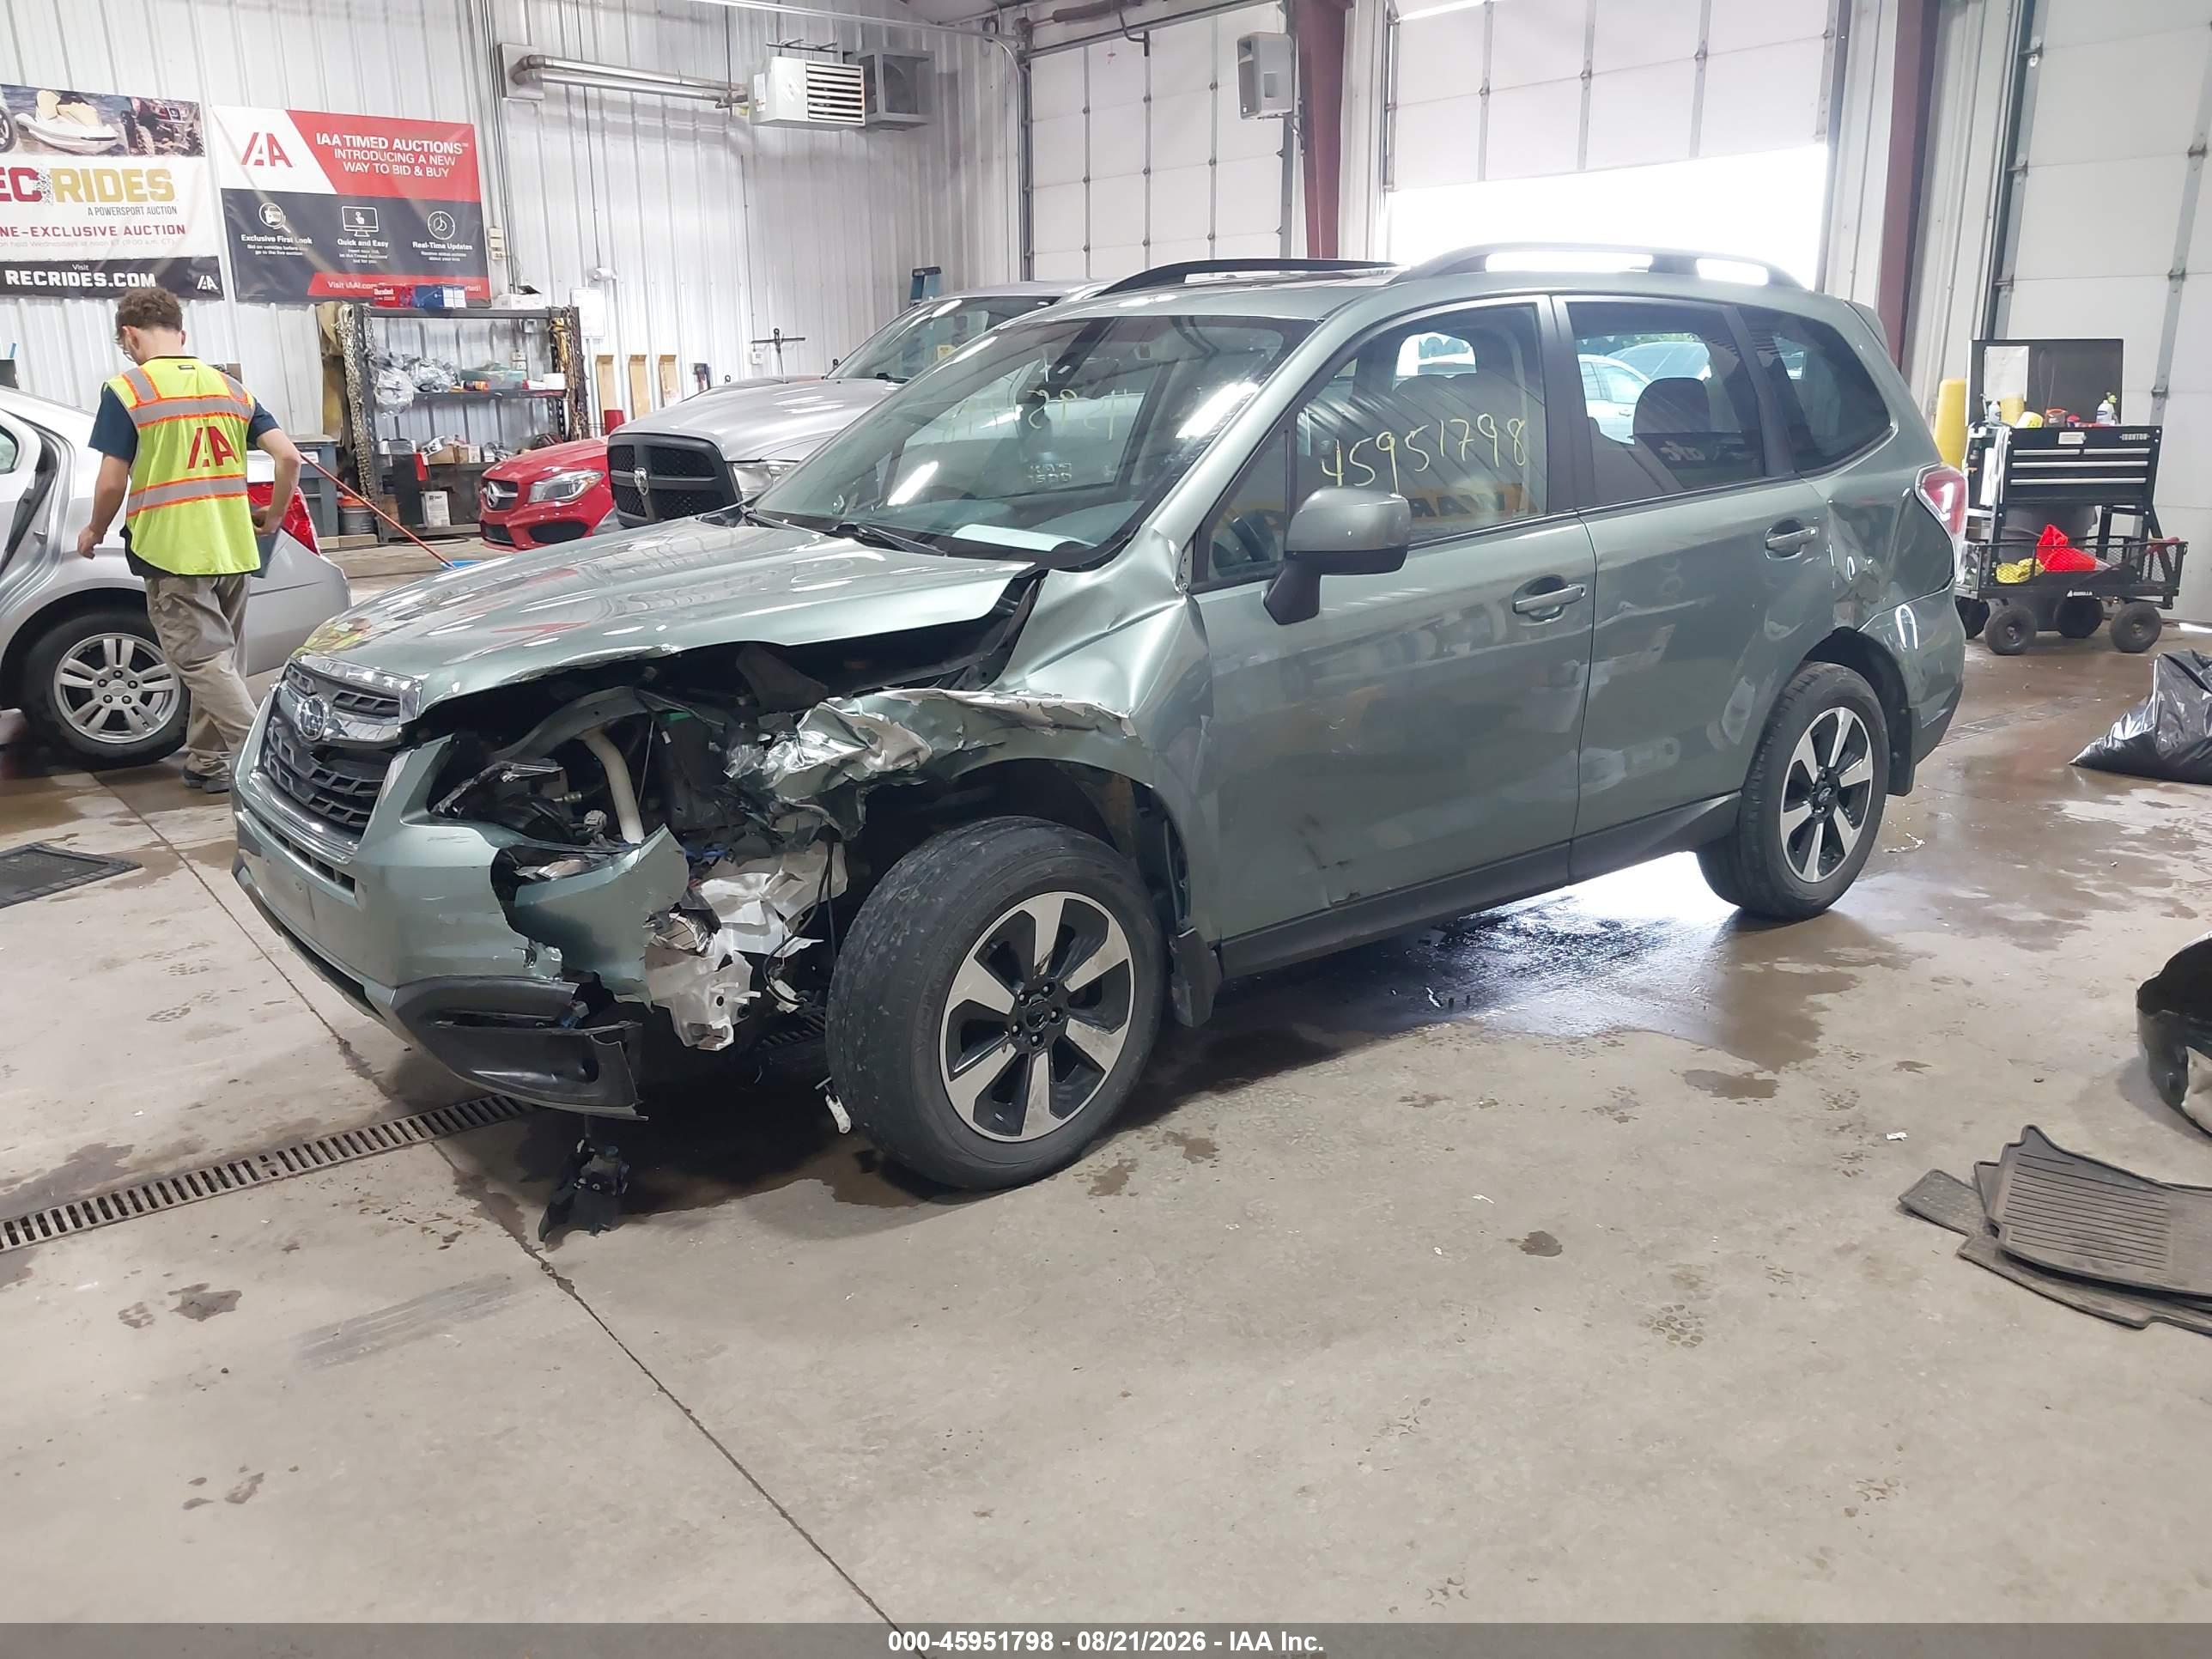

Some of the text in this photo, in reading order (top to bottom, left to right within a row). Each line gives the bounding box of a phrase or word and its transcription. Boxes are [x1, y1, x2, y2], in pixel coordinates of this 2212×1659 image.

[316, 132, 342, 147] IAA
[343, 135, 388, 149] TIMED
[334, 148, 456, 166] INTRODUCING A NEW
[343, 161, 450, 178] WAY TO BID & BUY
[50, 167, 176, 203] RIDES
[88, 205, 178, 216] A POWERSPORT AUCTION
[124, 224, 186, 236] AUCTION
[240, 234, 276, 242] Exclusive
[337, 238, 356, 246] Quick
[372, 239, 389, 248] Easy
[412, 240, 473, 251] Real-Time Updates
[72, 263, 89, 271] Visit
[4, 270, 156, 289] RECRIDES.COM
[1320, 413, 1526, 495] 45951798
